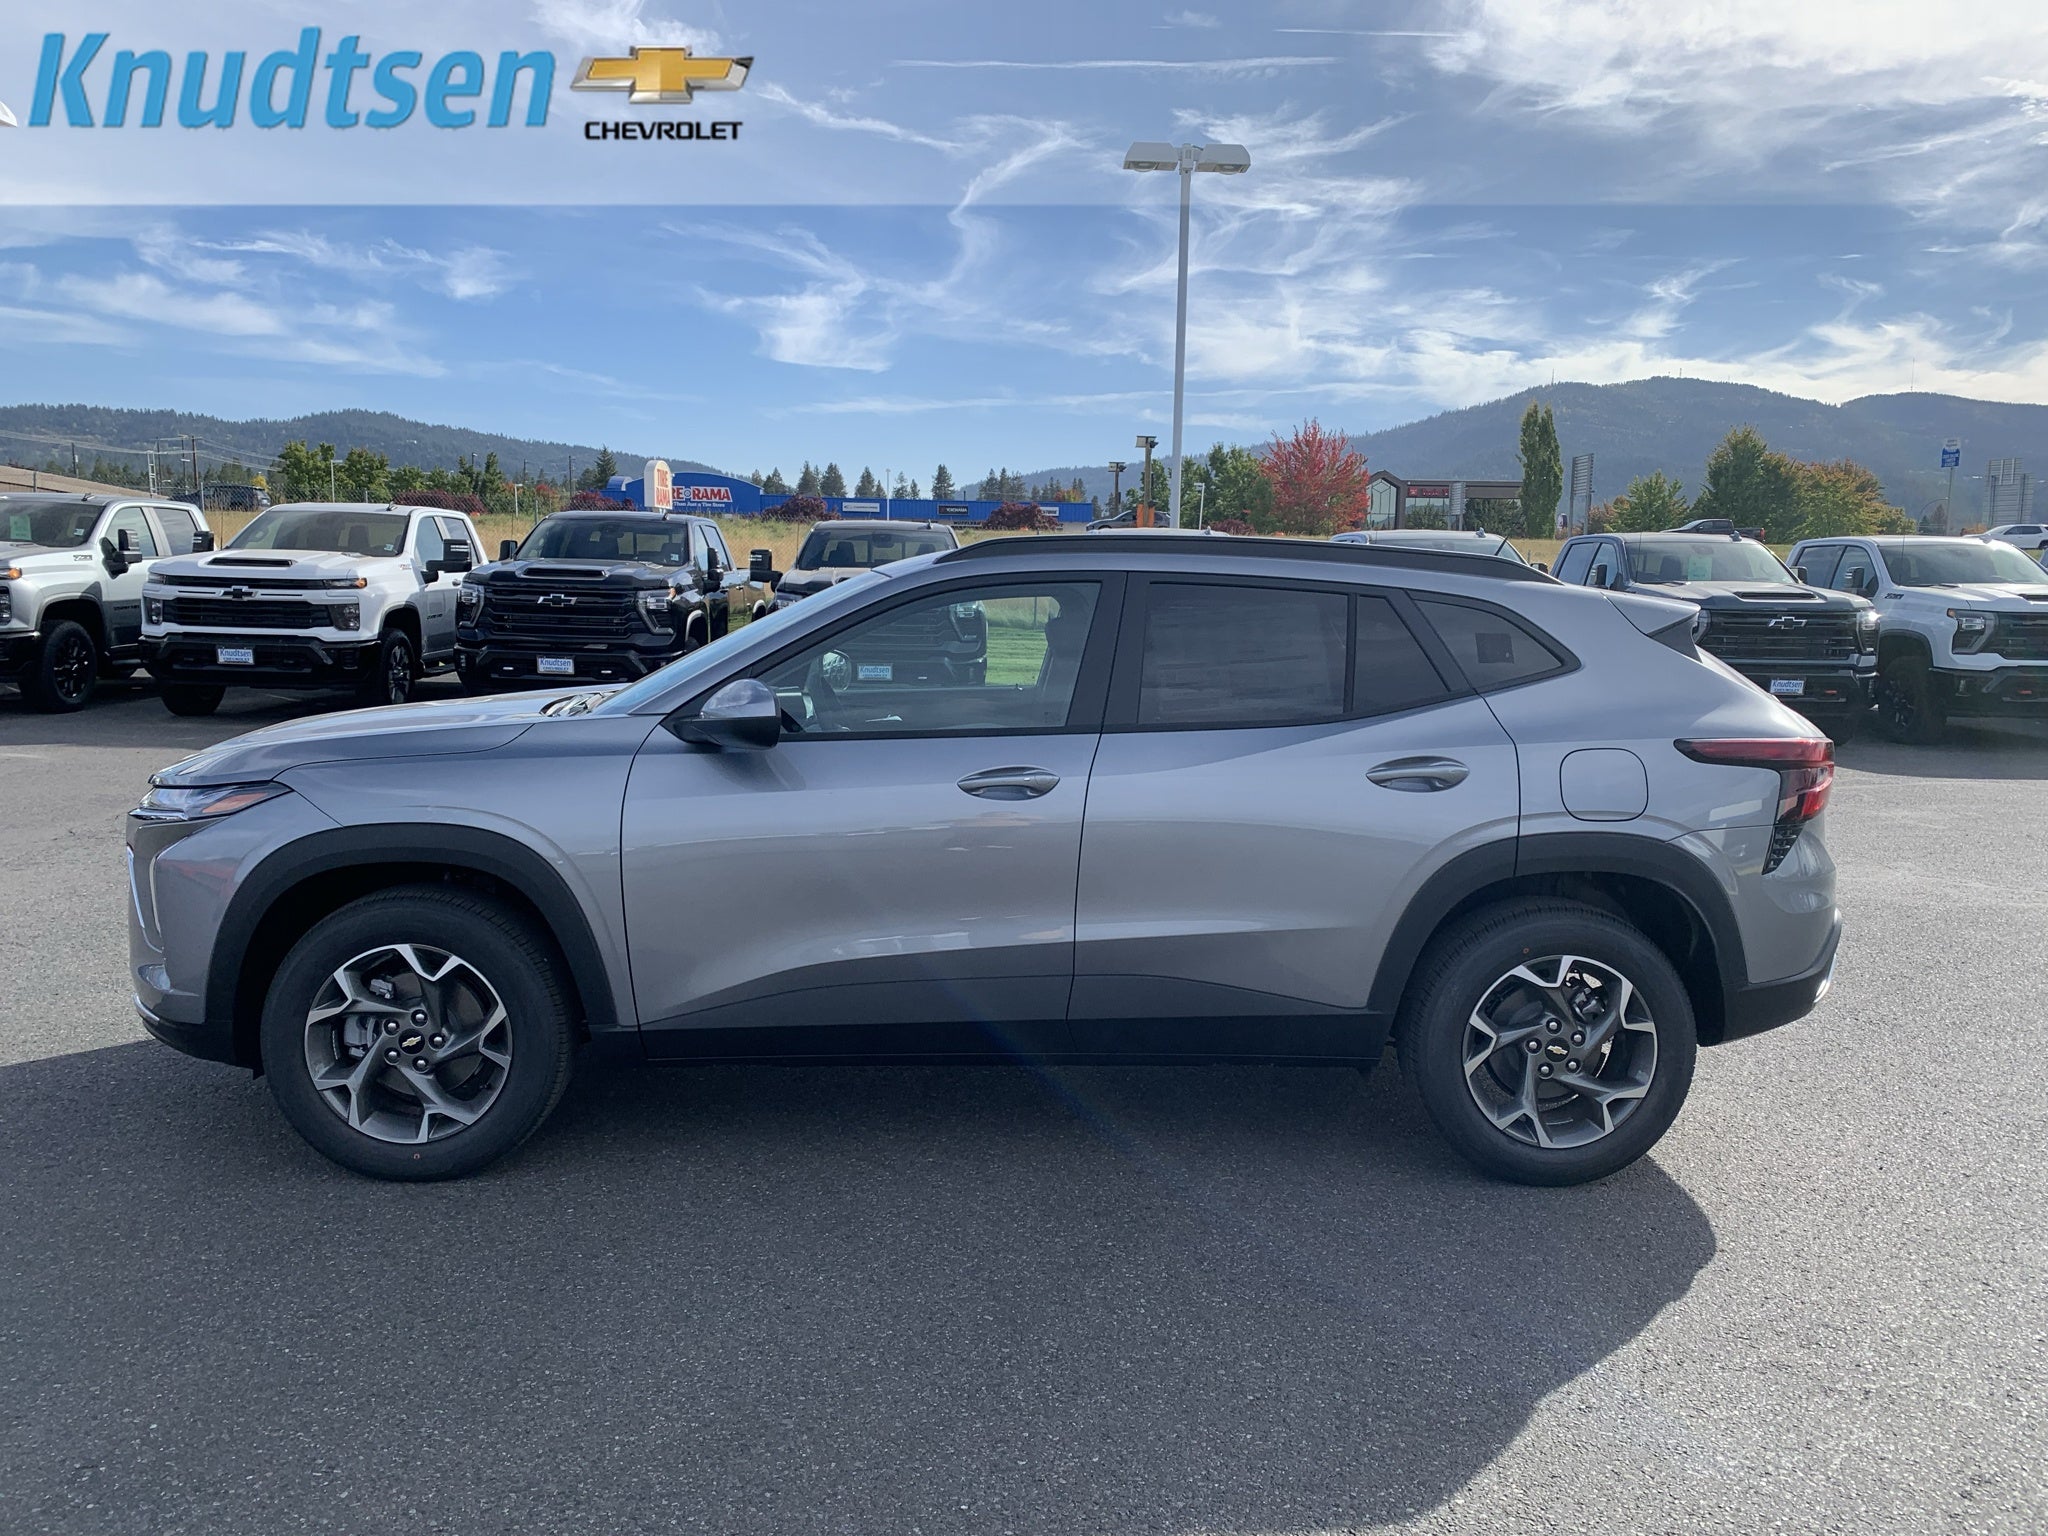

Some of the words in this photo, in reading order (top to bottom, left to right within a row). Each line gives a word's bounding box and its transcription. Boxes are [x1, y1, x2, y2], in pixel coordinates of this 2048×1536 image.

[657, 469, 668, 488] TIRE
[656, 487, 671, 507] RAMA
[692, 487, 731, 500] RAMA
[540, 659, 571, 667] Knudtsen
[1772, 680, 1802, 688] Knudtsen
